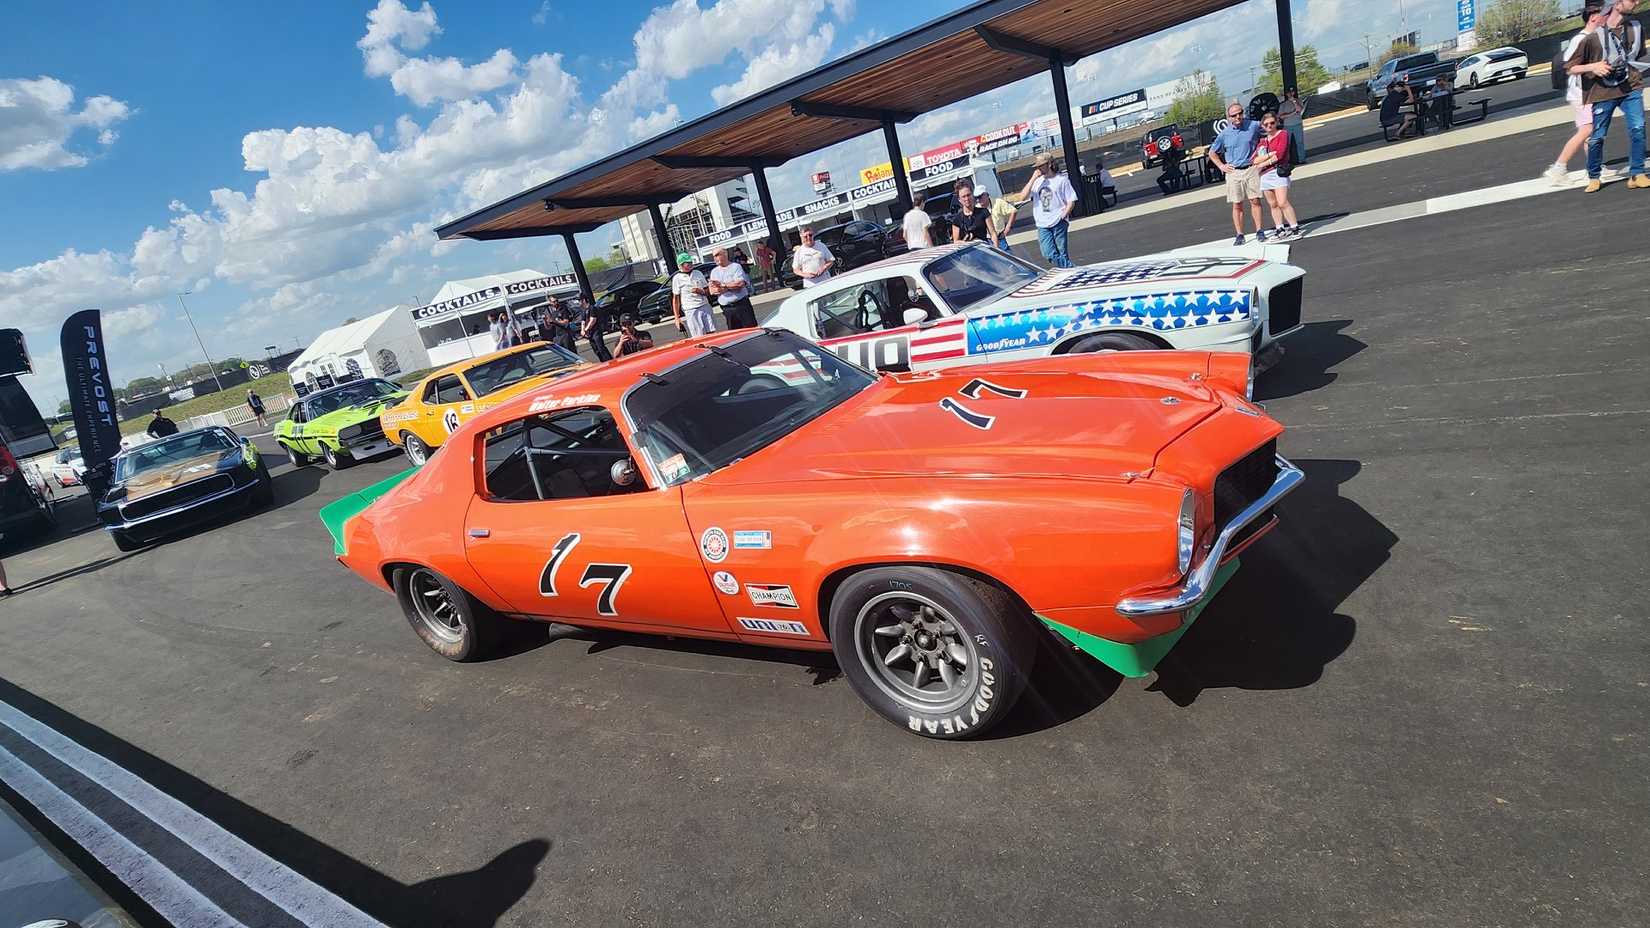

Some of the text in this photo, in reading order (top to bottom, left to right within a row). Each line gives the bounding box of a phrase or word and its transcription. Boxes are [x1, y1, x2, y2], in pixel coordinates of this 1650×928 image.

[1099, 98, 1114, 112] CUP
[1114, 92, 1139, 107] SERIES
[927, 147, 962, 164] TOYOTA
[925, 161, 954, 177] FOOD
[854, 178, 896, 198] COCKTAI
[804, 196, 840, 214] SNACKS
[709, 230, 732, 243] FOOD
[511, 275, 573, 294] COCKTAILS
[418, 288, 495, 318] COCKTAILS
[976, 338, 1026, 352] GOODYEAR
[84, 325, 112, 427] PREVOST
[939, 376, 1029, 431] 17
[539, 532, 633, 617] 17
[751, 591, 792, 602] CHAMPION
